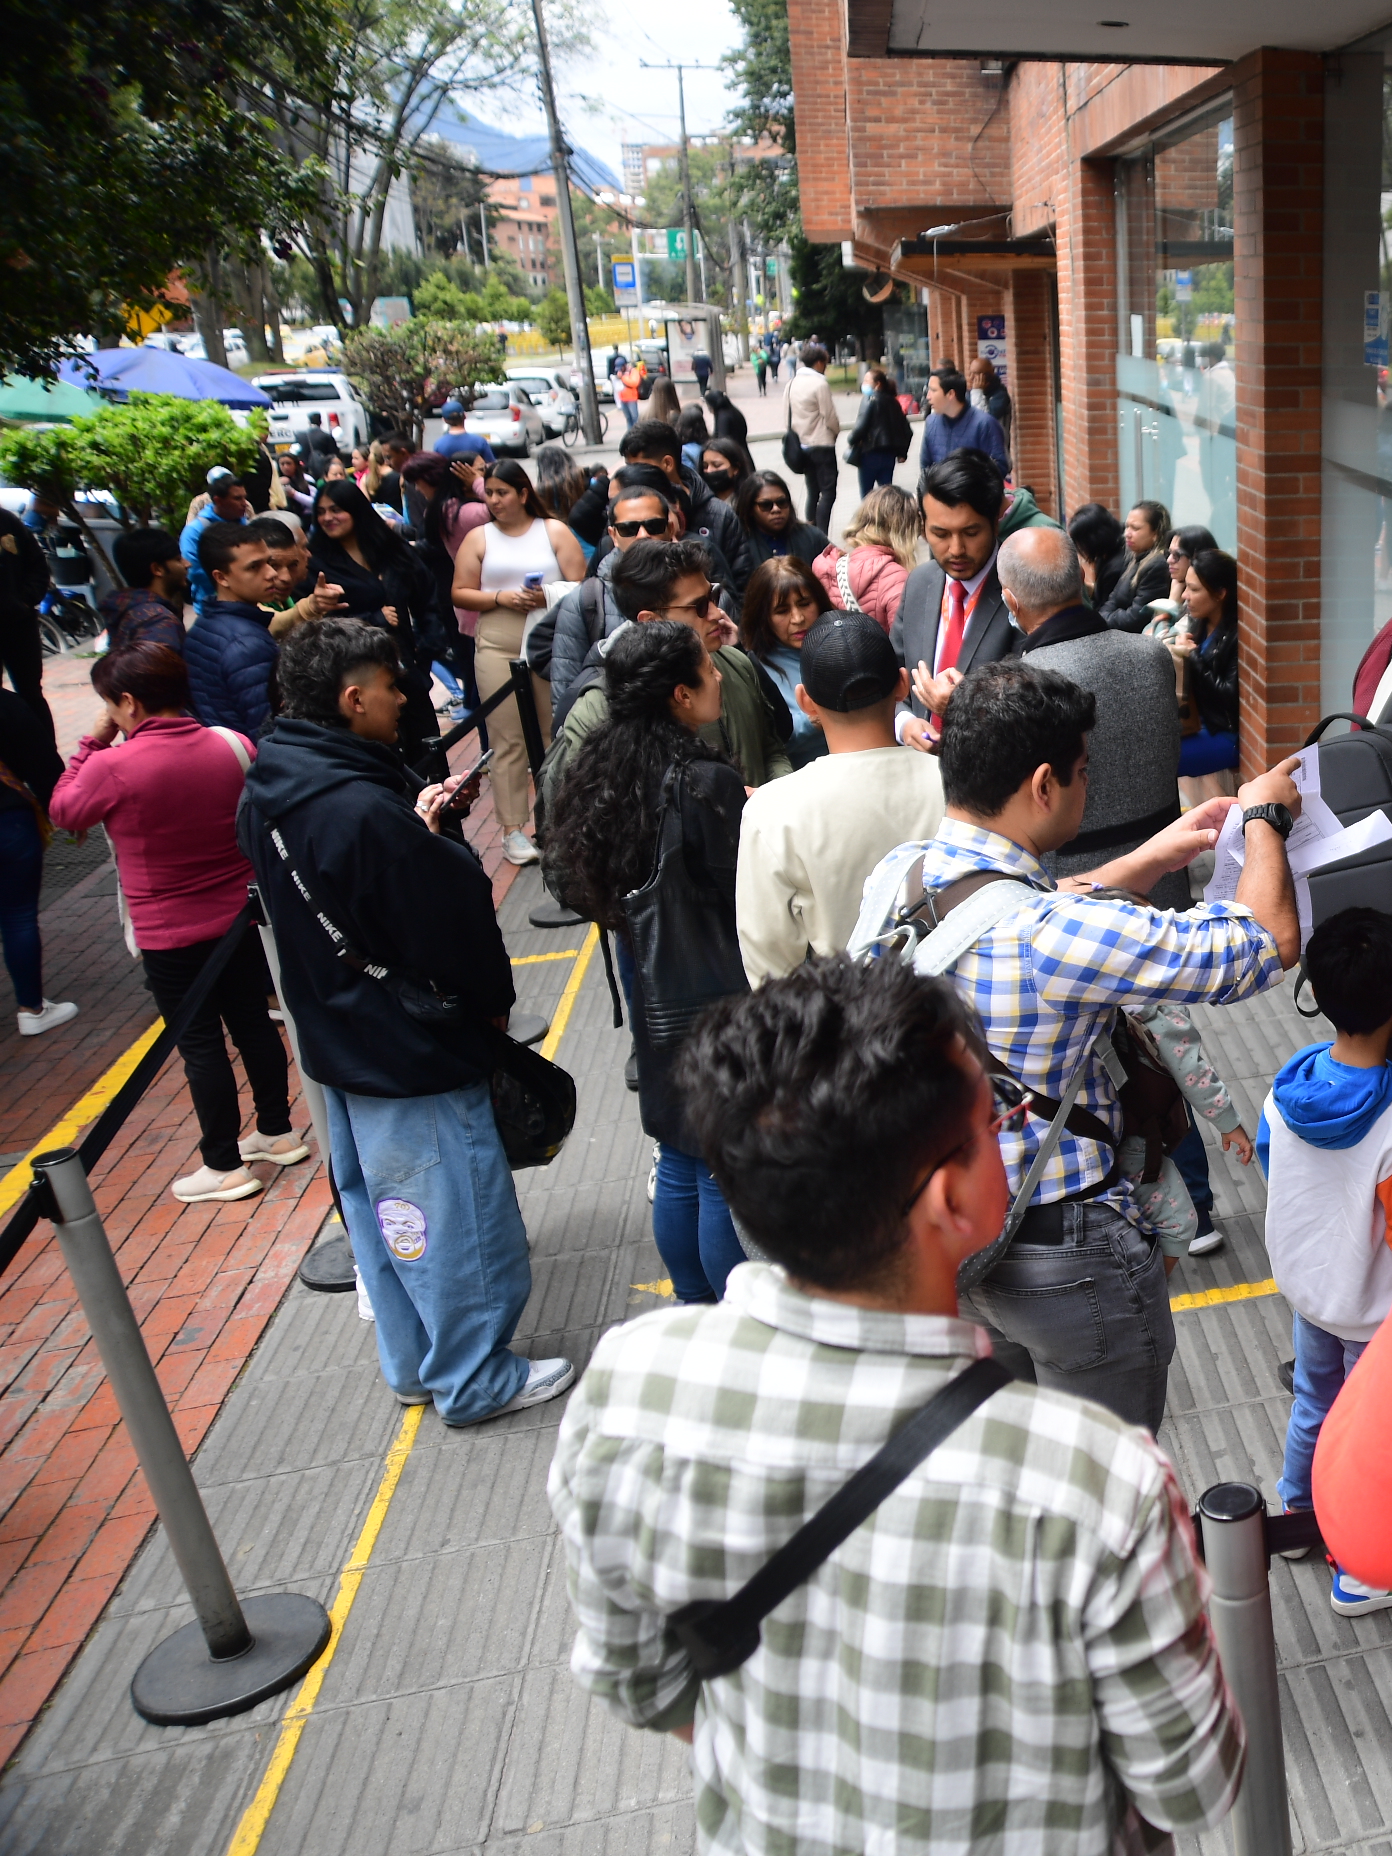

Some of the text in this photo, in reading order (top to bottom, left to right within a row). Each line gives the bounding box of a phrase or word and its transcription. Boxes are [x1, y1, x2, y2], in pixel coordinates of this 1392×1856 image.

[270, 828, 289, 861] NIKE
[291, 870, 312, 902] NIKE
[316, 911, 343, 943] NIKE
